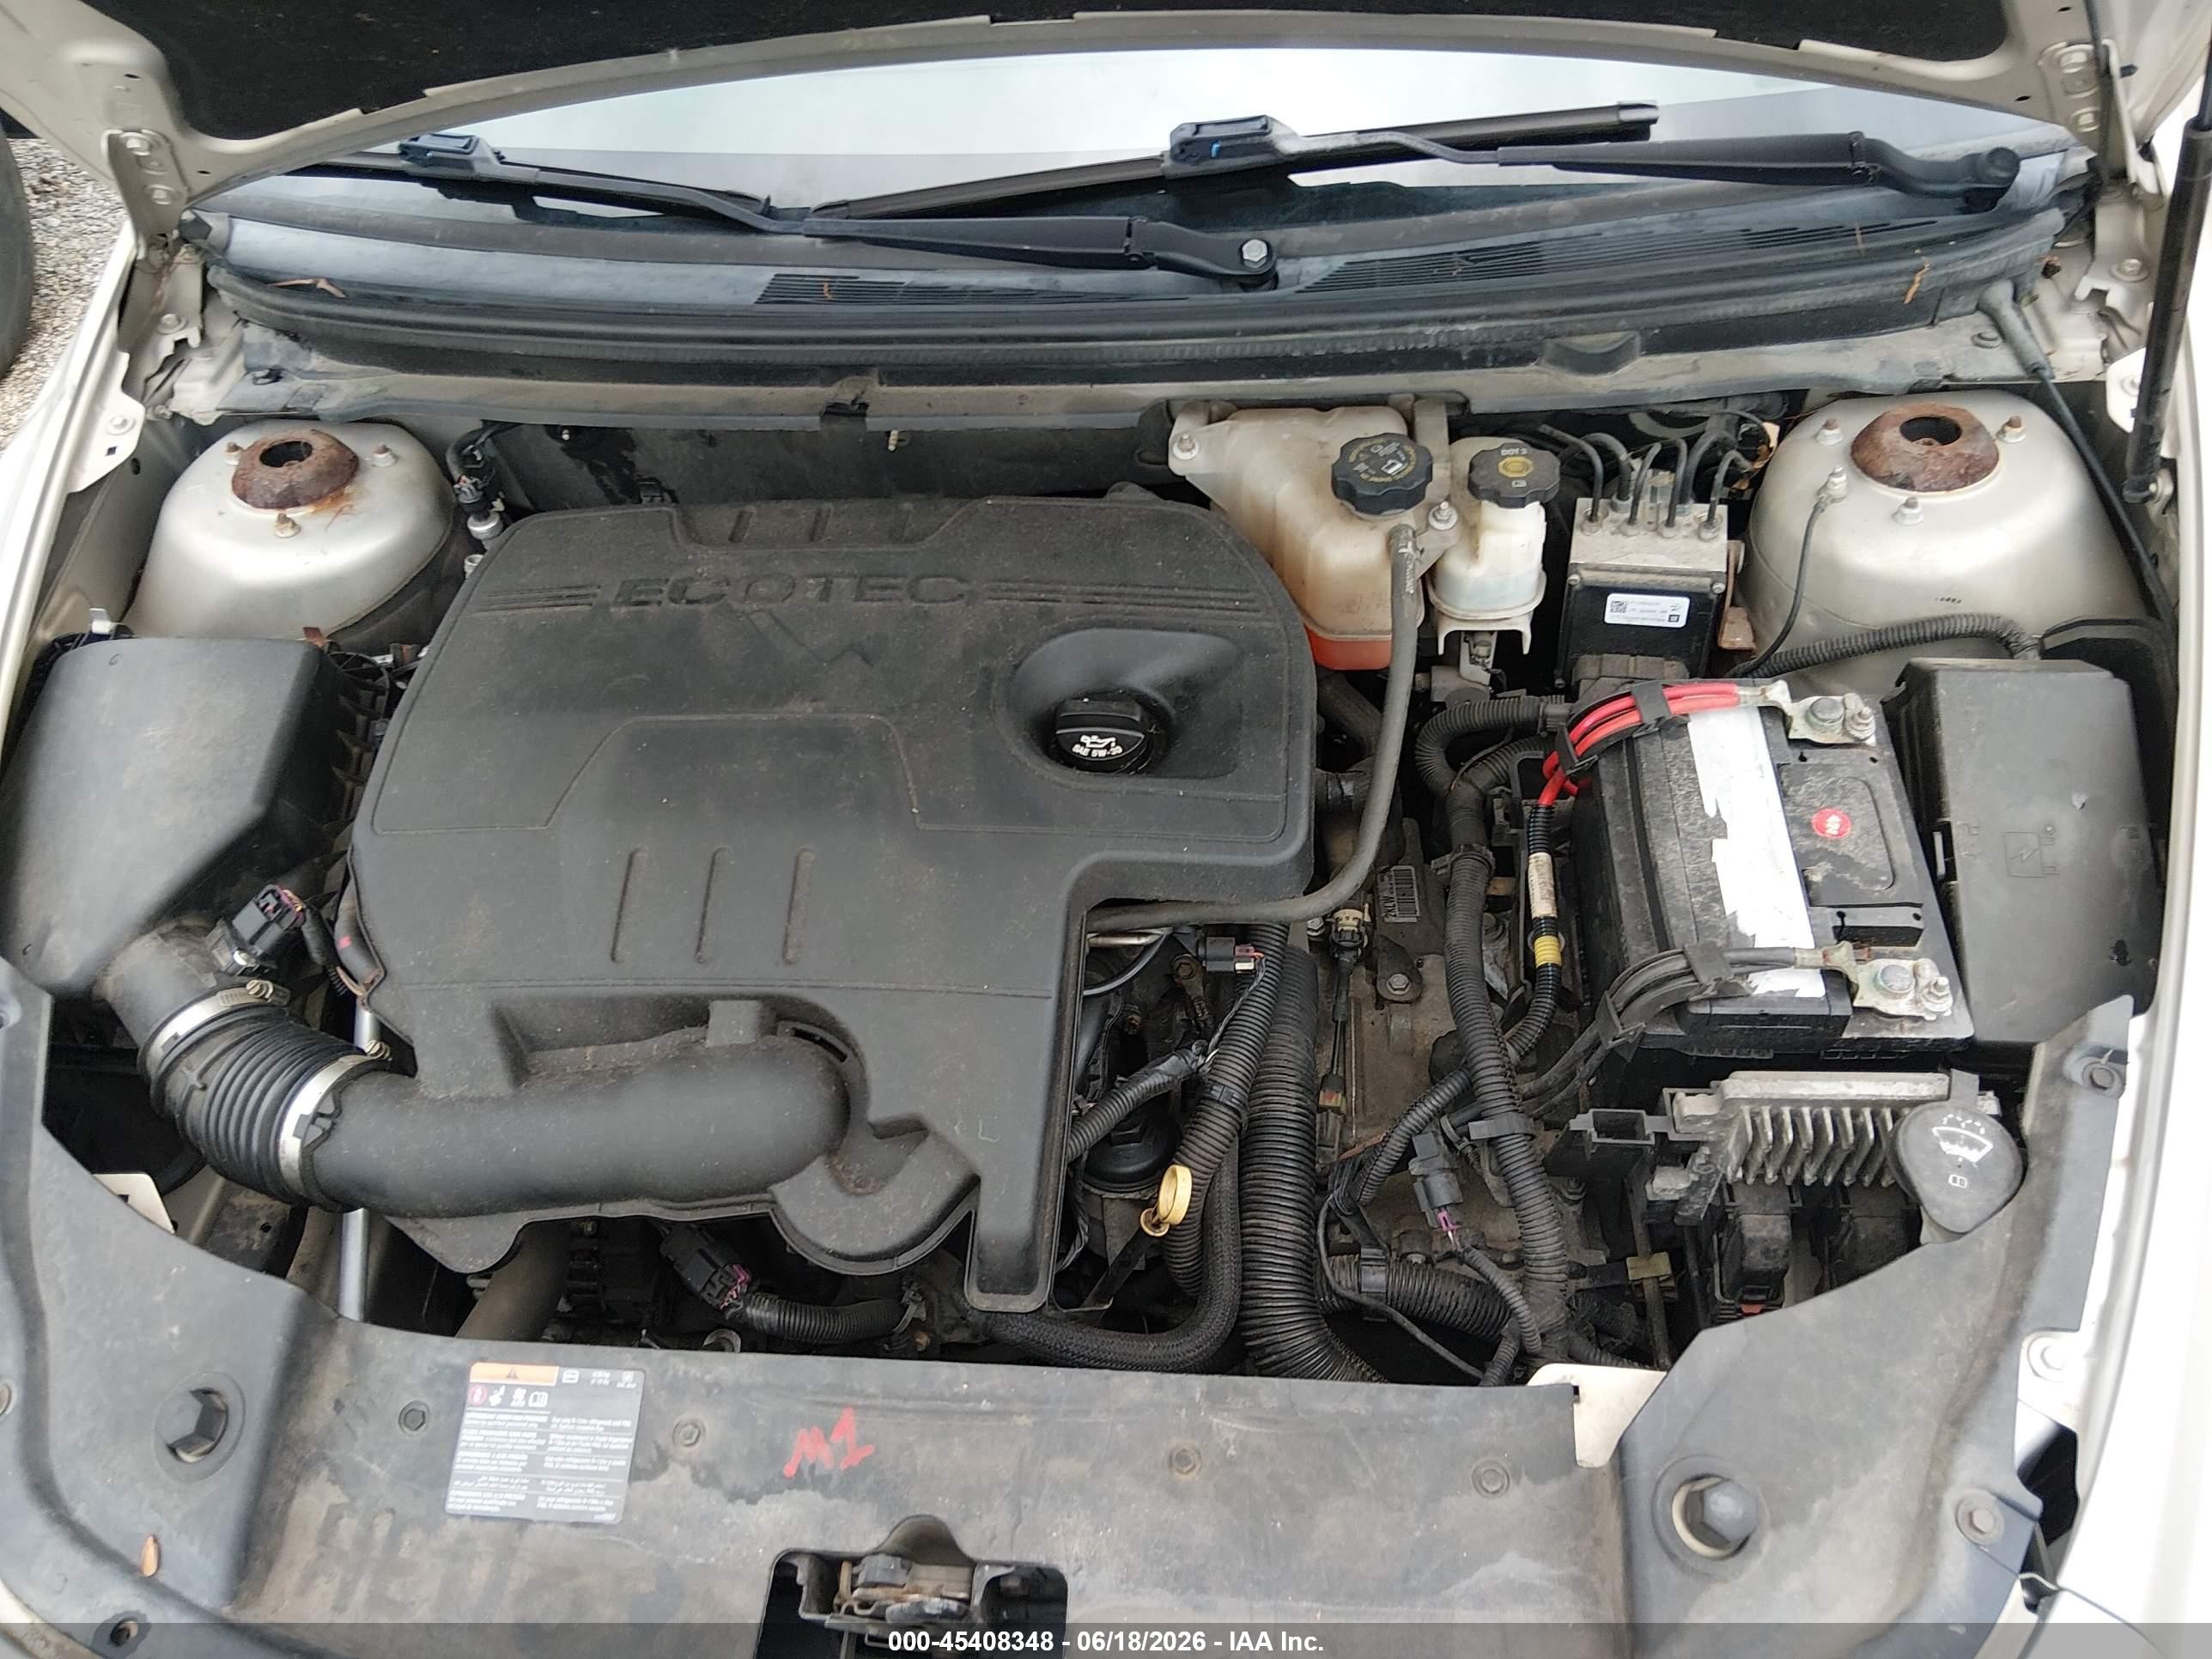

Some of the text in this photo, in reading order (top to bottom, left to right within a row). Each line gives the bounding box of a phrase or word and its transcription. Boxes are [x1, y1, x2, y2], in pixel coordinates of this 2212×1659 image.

[612, 573, 970, 607] ECOTEC
[1072, 744, 1091, 757] SAE
[783, 1407, 875, 1478] M1
